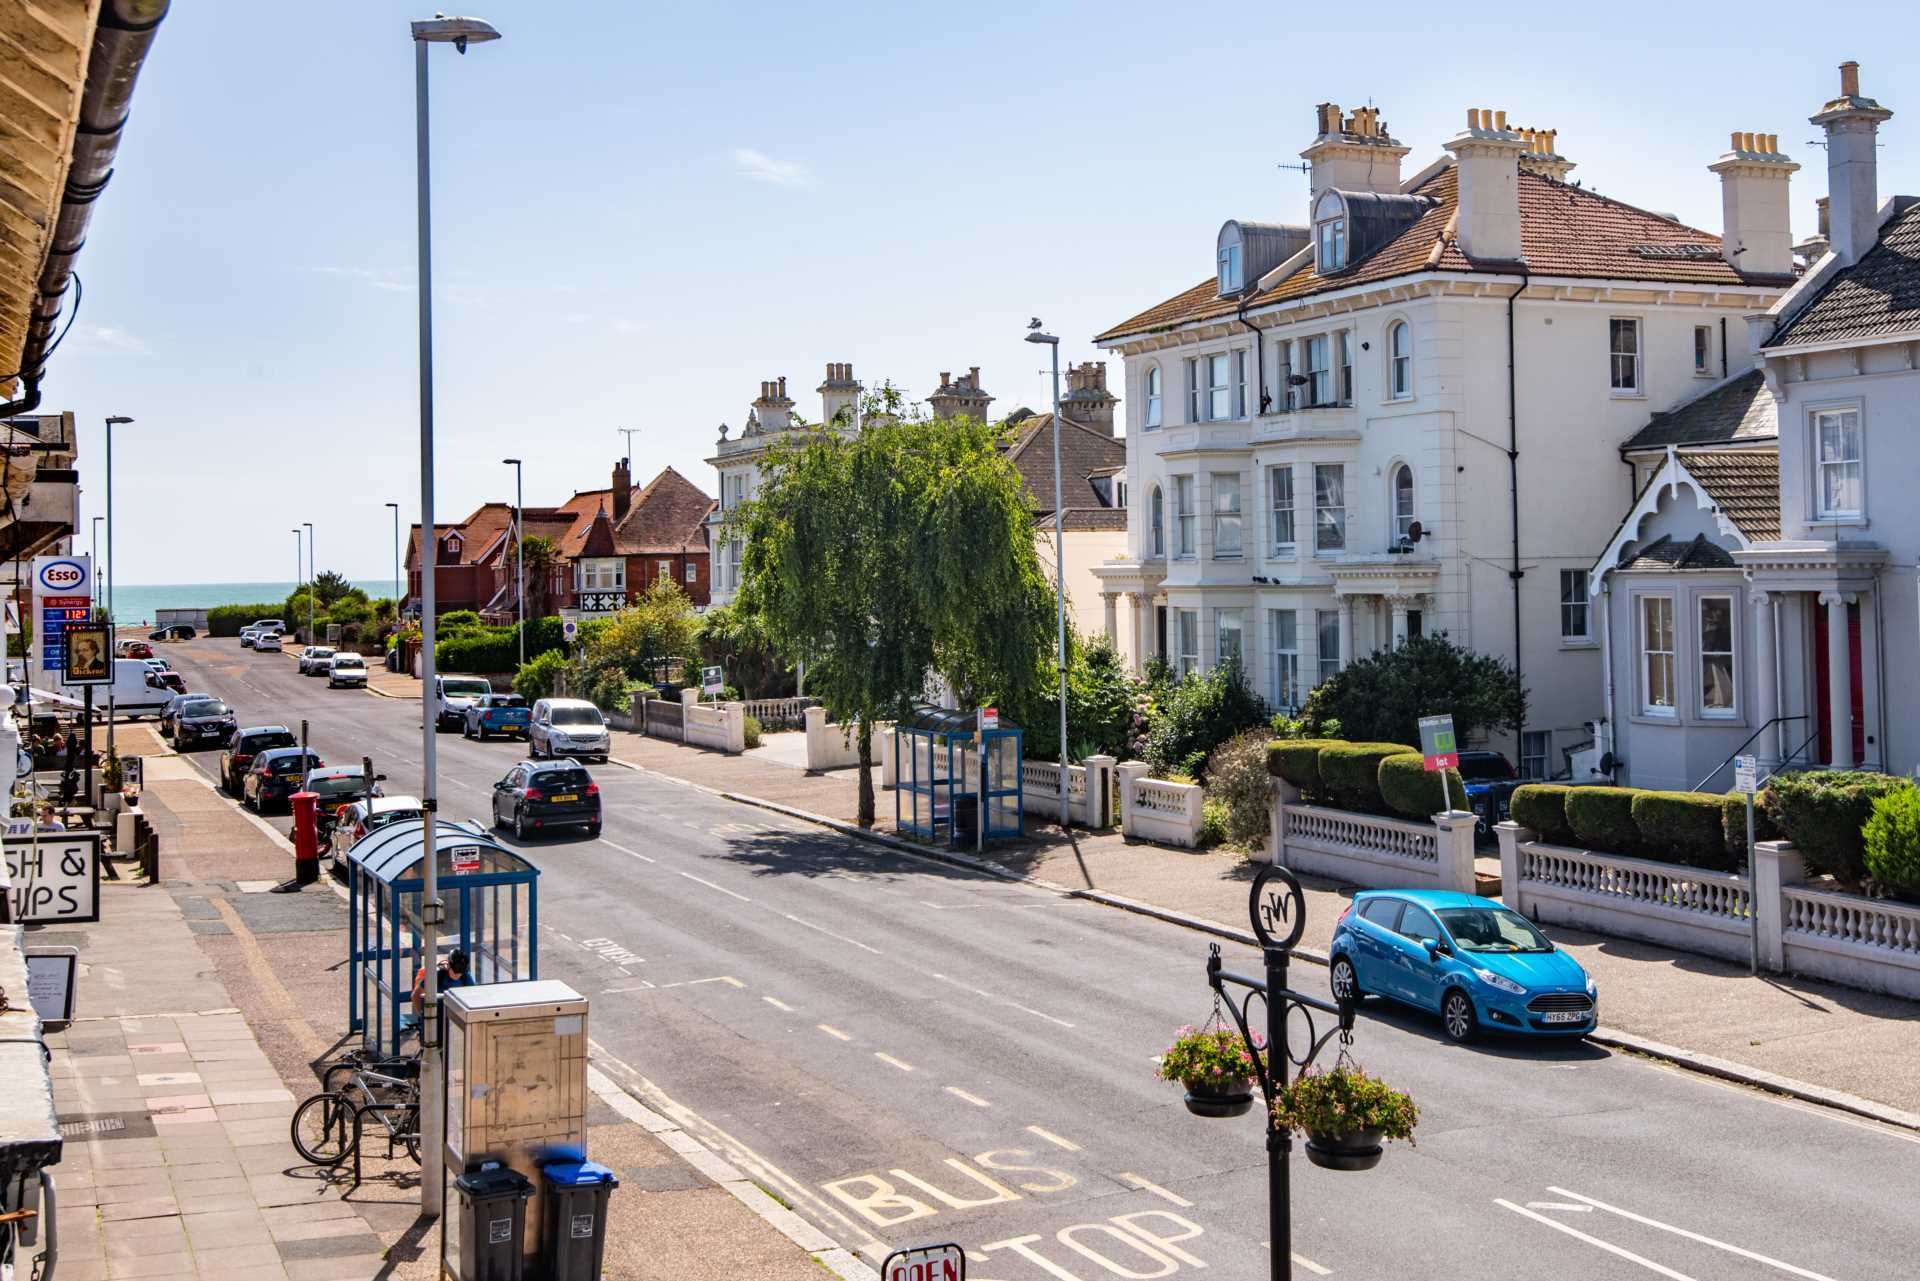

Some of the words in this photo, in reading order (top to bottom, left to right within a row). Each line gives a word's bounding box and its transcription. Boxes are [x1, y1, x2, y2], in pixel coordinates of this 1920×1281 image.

[48, 569, 79, 580] Esso
[61, 848, 86, 876] &
[821, 1147, 1078, 1228] BUS
